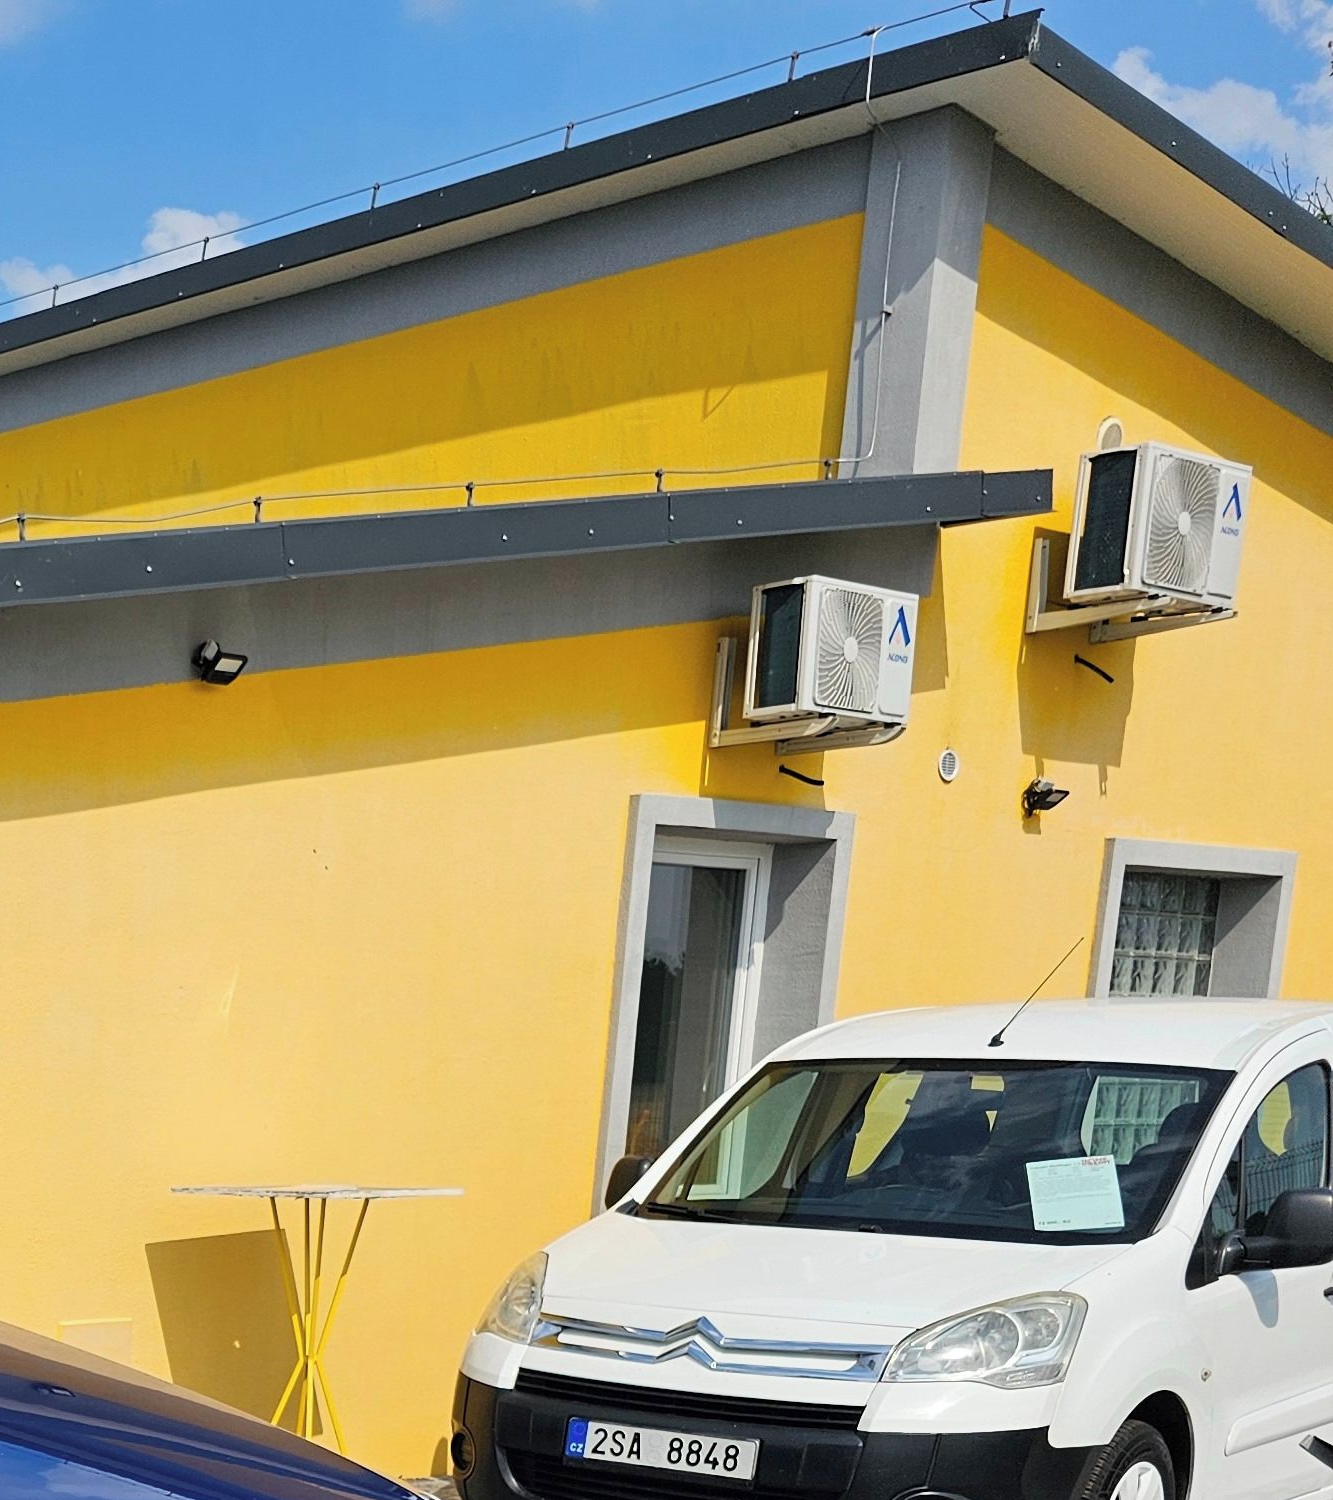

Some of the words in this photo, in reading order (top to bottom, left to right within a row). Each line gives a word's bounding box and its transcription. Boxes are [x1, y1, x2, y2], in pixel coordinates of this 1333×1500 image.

[569, 1442, 583, 1453] CZ
[591, 1428, 642, 1460] 2SA
[667, 1437, 740, 1472] 8848
